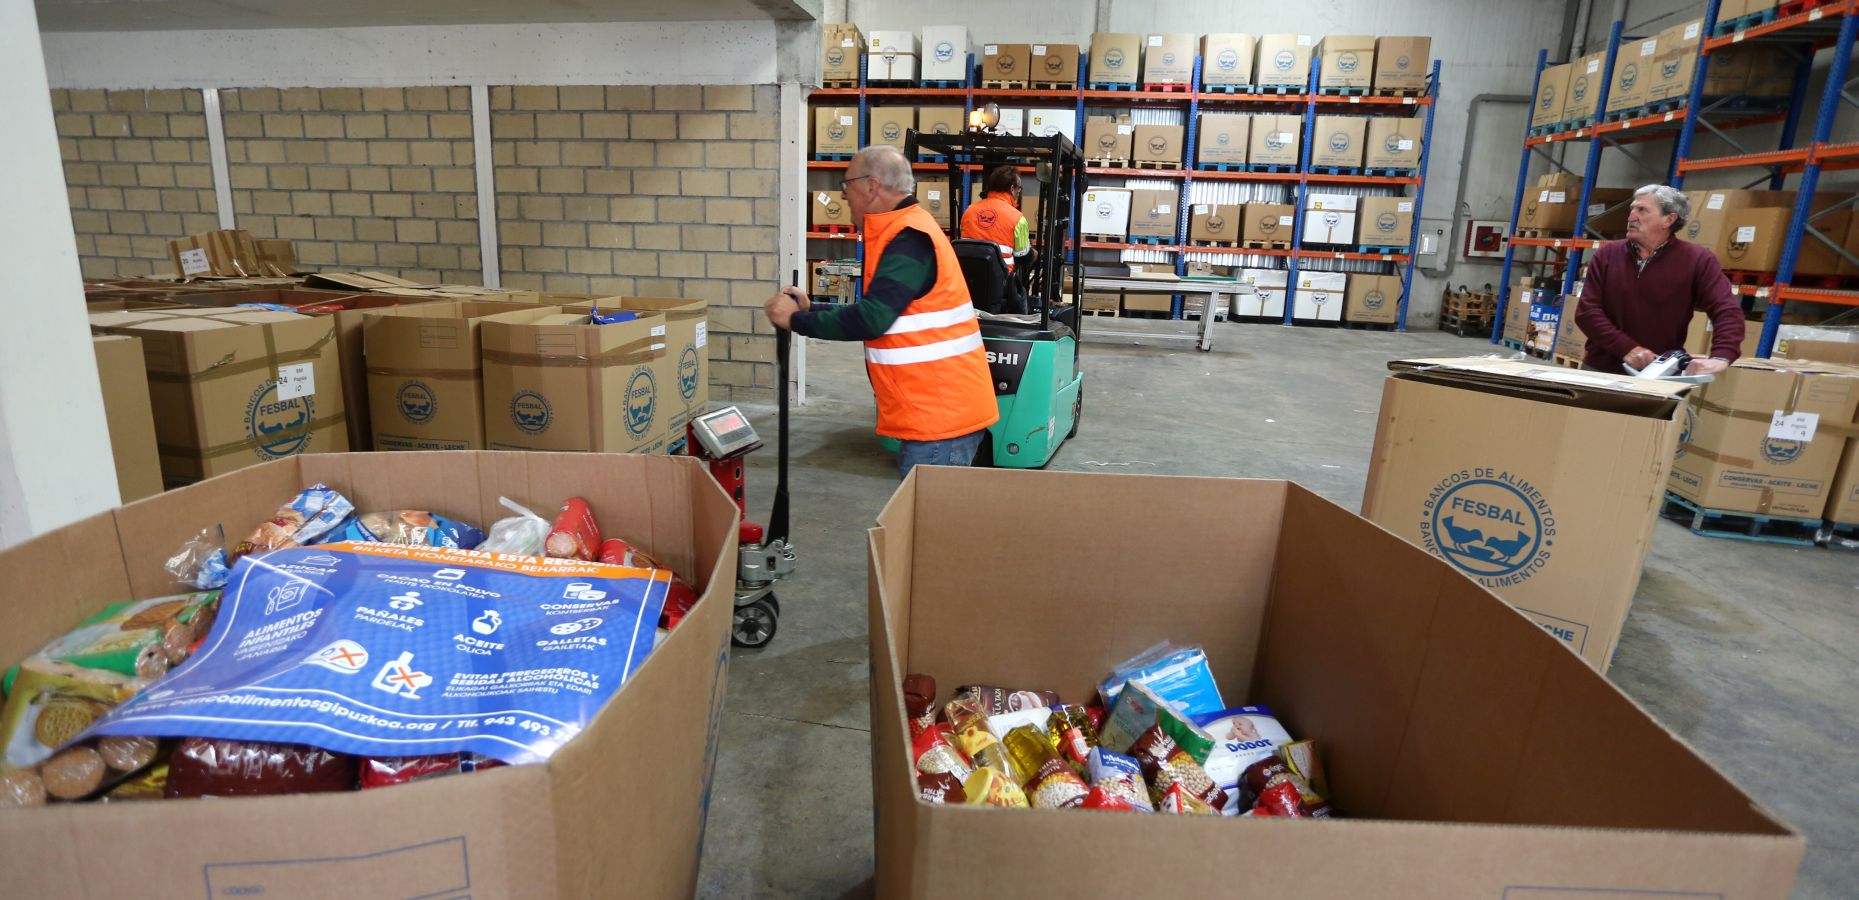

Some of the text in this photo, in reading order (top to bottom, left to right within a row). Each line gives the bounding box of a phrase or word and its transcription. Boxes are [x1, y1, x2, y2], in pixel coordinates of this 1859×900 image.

[631, 386, 652, 399] FESBAL
[244, 384, 265, 424] BANCOS
[260, 399, 301, 416] FESBAL
[1723, 475, 1763, 485] CONSERVAS
[1423, 467, 1556, 536] BANCOS DE ALIMENTOS
[1451, 496, 1526, 526] FESBAL
[352, 545, 601, 573] BILKETA HONETARAKO BEHARRAK:
[498, 552, 537, 565] ESTA
[376, 573, 431, 585] CACAO
[454, 583, 501, 598] POLVO
[383, 578, 417, 587] HAUTS
[539, 599, 620, 610] CONSERVAS
[243, 608, 324, 640] ALIMENTOS
[353, 613, 415, 632] PARDELAK
[355, 606, 425, 626] PAÑALES
[238, 618, 318, 649] INFANTILES
[453, 633, 505, 650] ACEITE
[535, 636, 608, 647] GALLETAS
[456, 643, 493, 656] OLIOA
[543, 643, 595, 651] GAILETAK
[449, 678, 504, 686] BEBIDAS
[453, 667, 600, 681] EVITAR PERECEDEROS Y
[517, 687, 559, 695] SAIHESTU
[549, 680, 564, 688] ETA
[565, 683, 593, 695] EDARI
[484, 716, 516, 726] 943
[519, 719, 551, 737] 493
